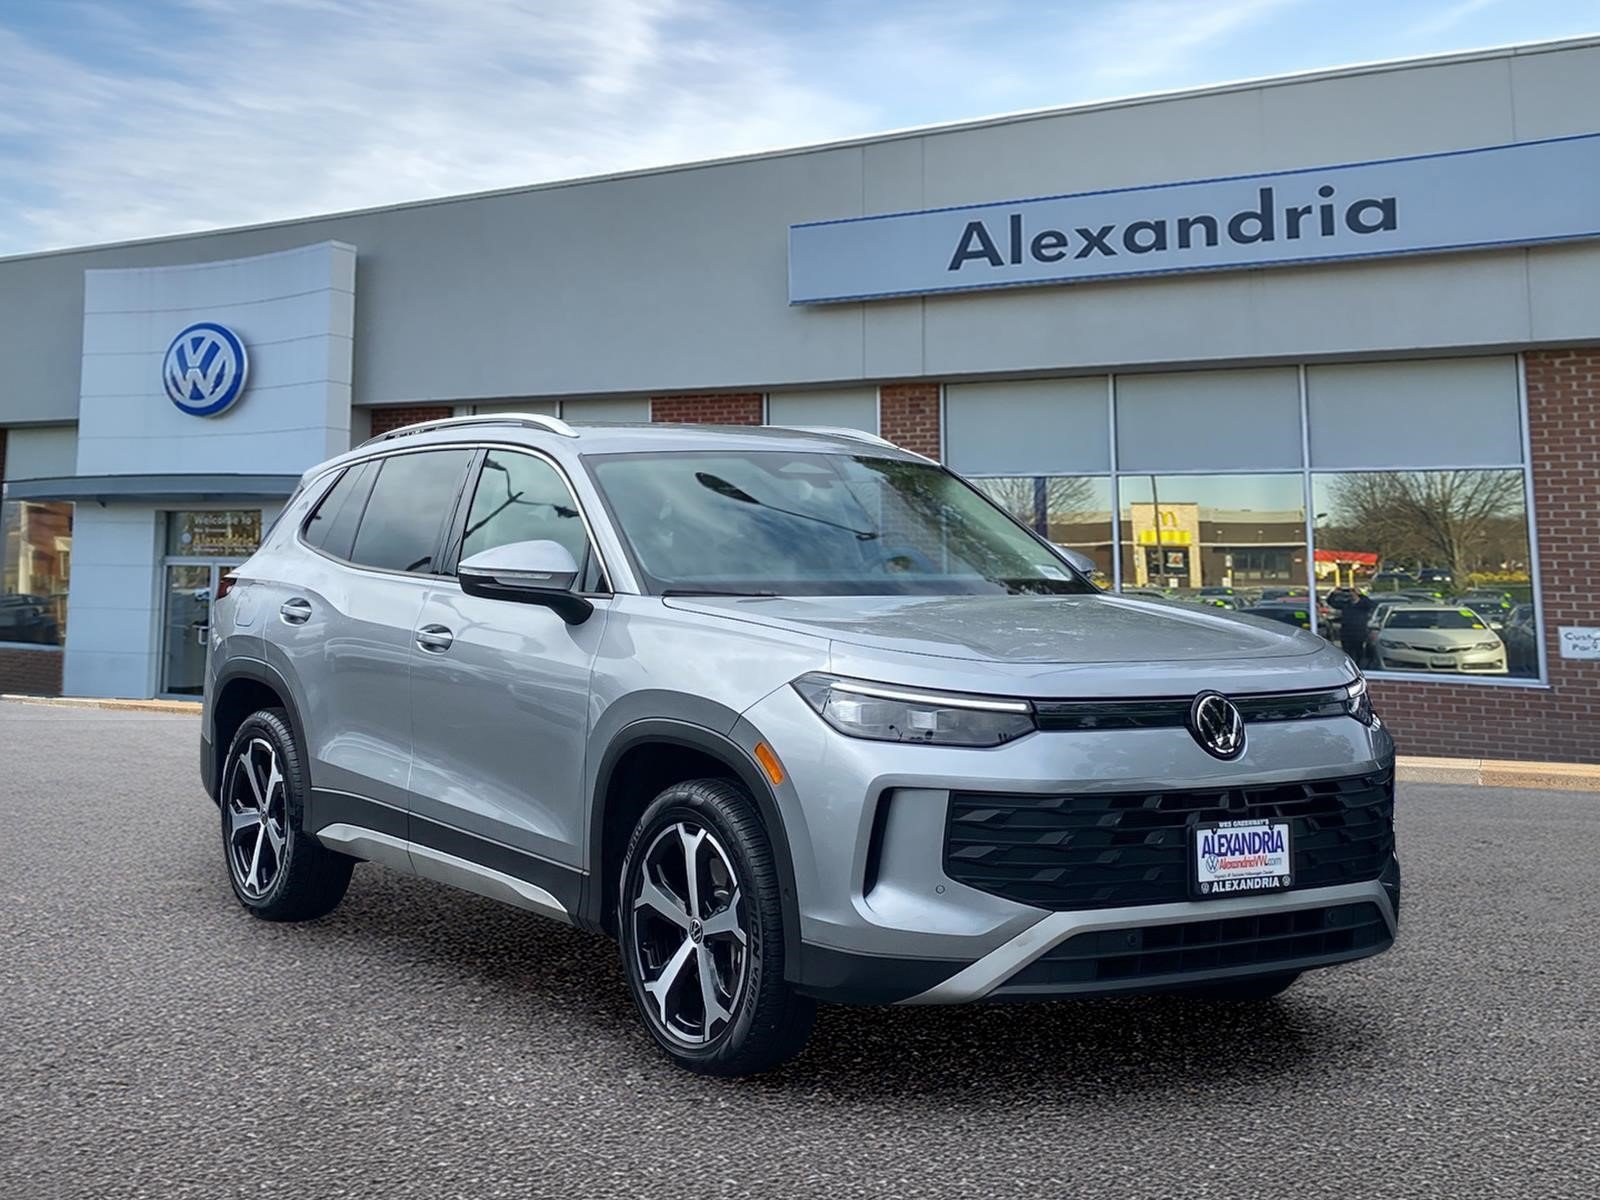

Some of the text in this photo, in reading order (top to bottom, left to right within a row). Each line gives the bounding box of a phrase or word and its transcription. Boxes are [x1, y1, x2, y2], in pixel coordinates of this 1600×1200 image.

[947, 185, 1397, 271] Alexandria
[165, 325, 242, 412] VW
[1201, 830, 1285, 858] ALEXANDRIA
[1212, 877, 1280, 893] ALEXANDRIA
